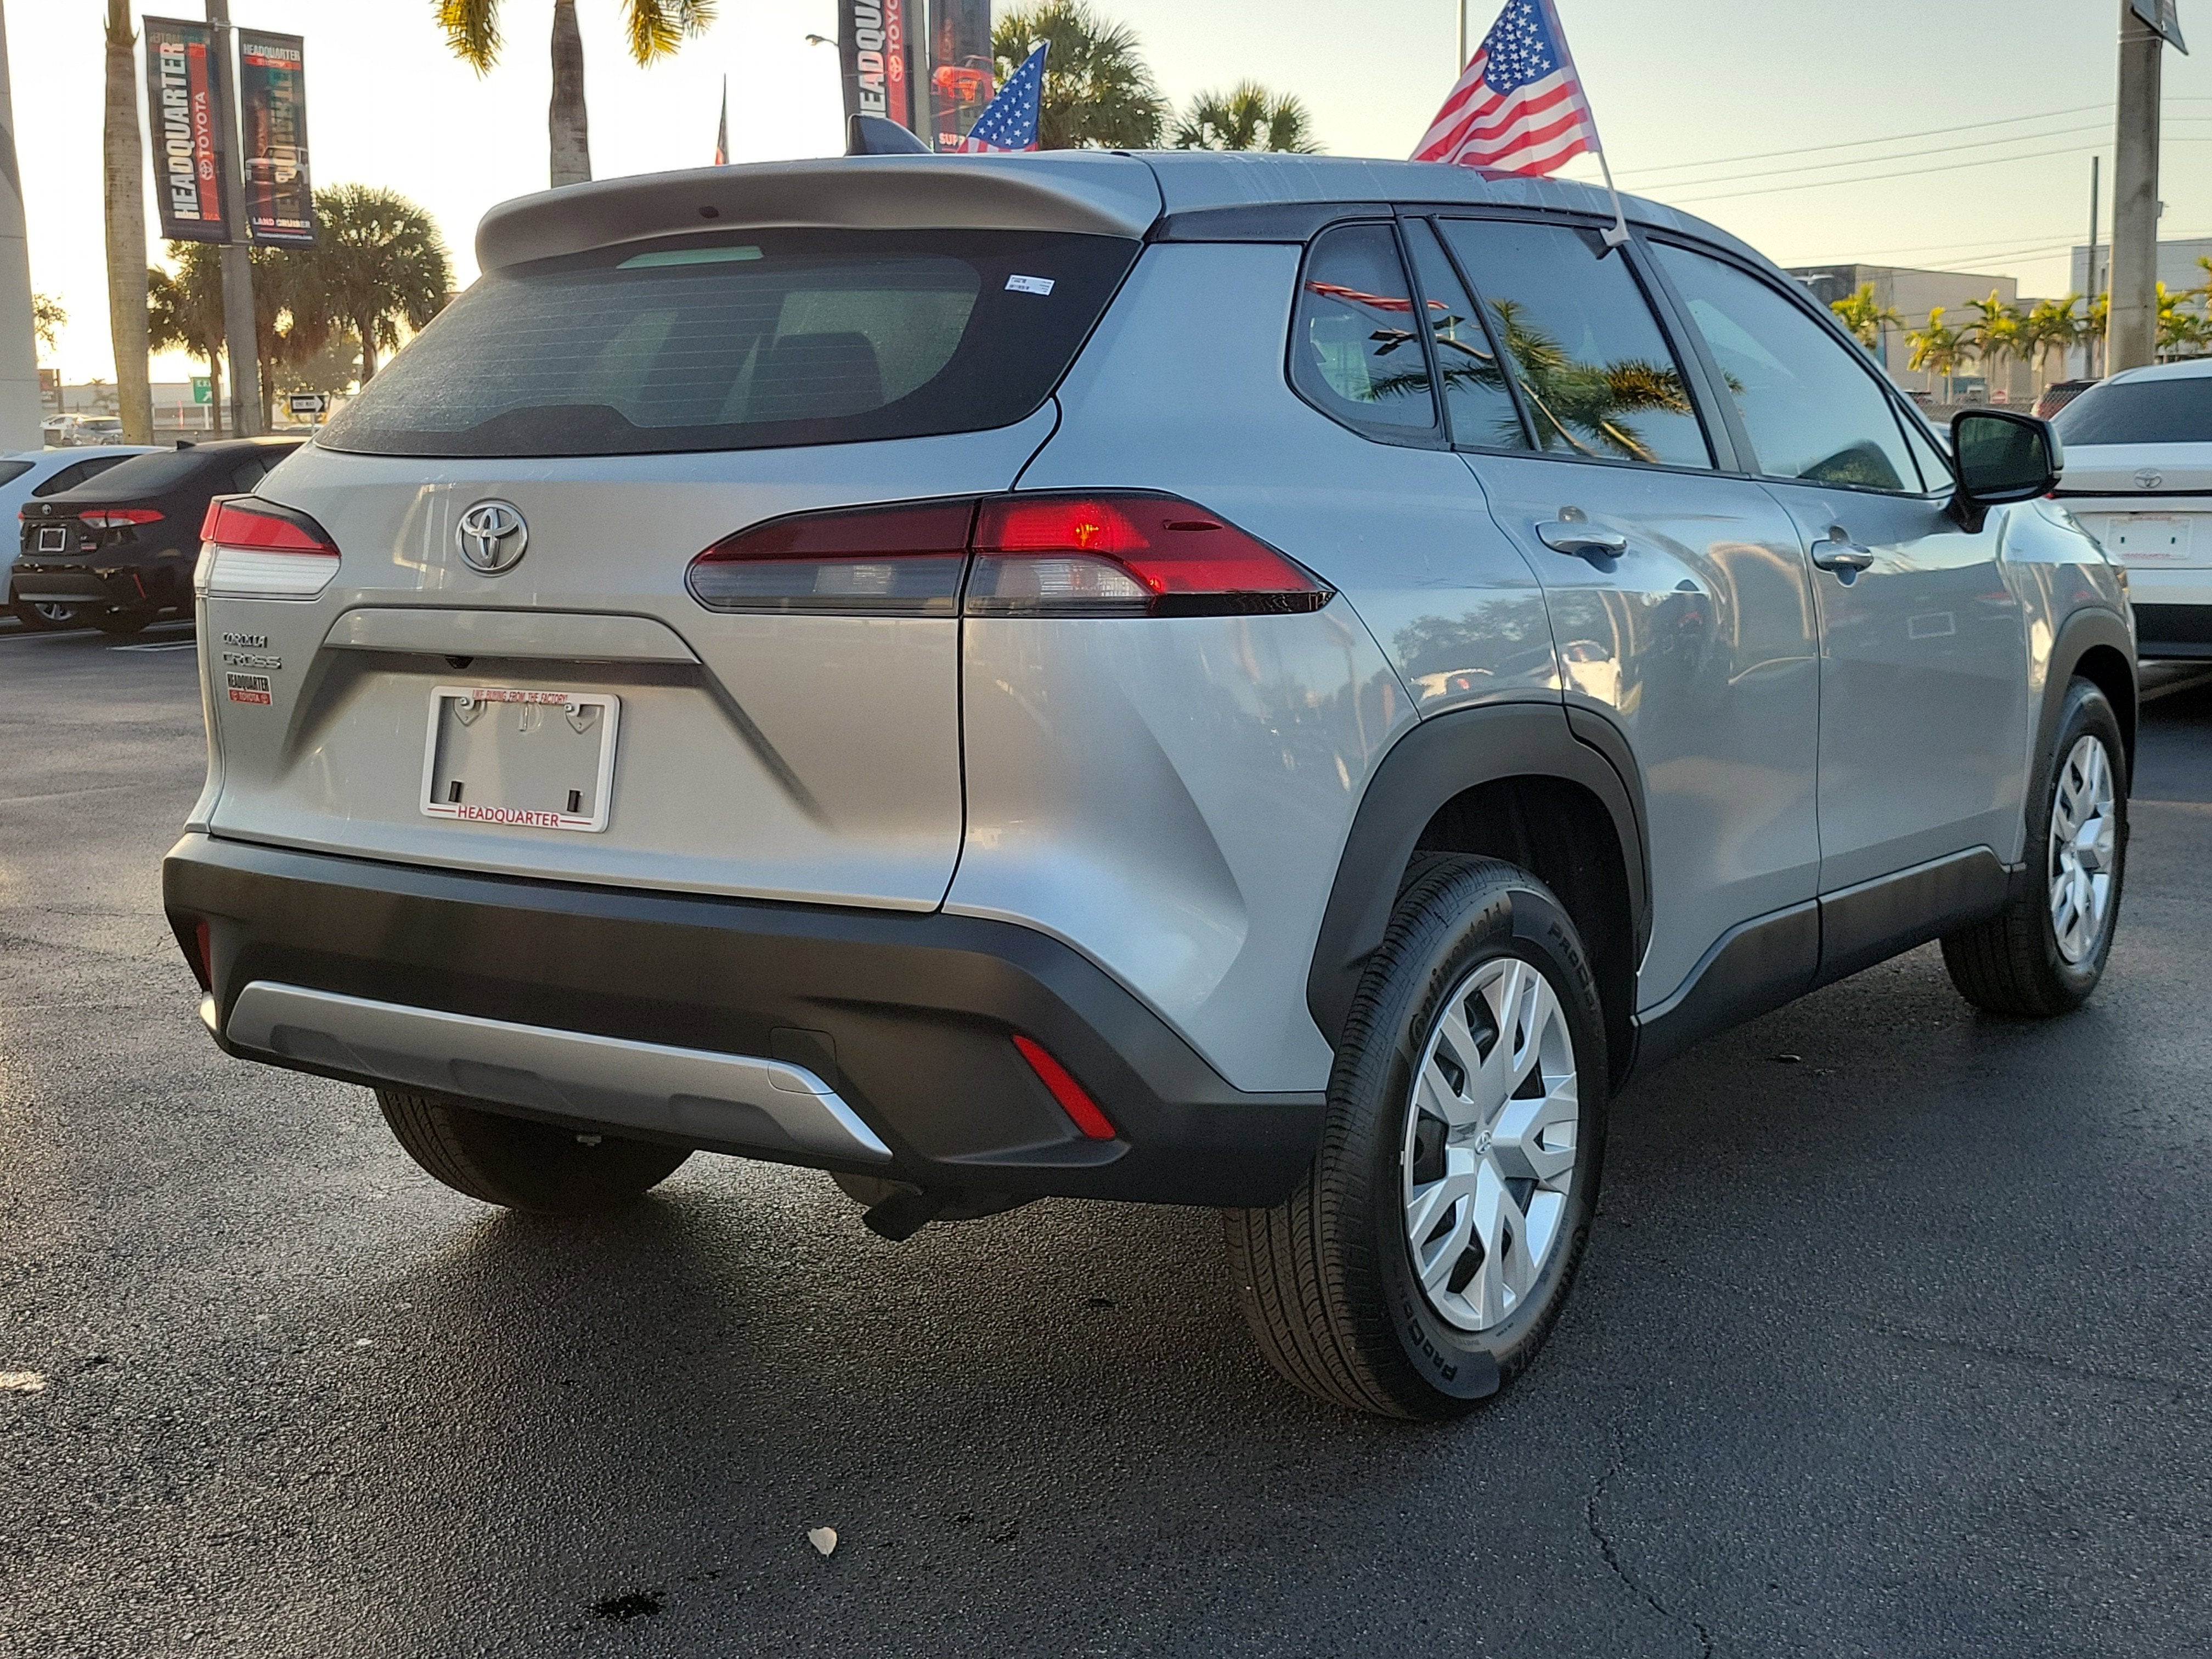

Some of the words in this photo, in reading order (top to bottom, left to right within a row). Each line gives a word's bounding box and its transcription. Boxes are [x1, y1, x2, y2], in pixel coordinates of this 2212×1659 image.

[243, 43, 301, 61] HEADQUARTER
[854, 0, 886, 117] EADQU
[159, 42, 200, 220] HEADQUARTER
[194, 92, 210, 157] TOYOTA
[223, 632, 267, 648] COROLLA
[223, 651, 281, 669] CROSS
[227, 674, 269, 692] HEADQUARTER
[458, 805, 560, 827] HEADQUARTER
